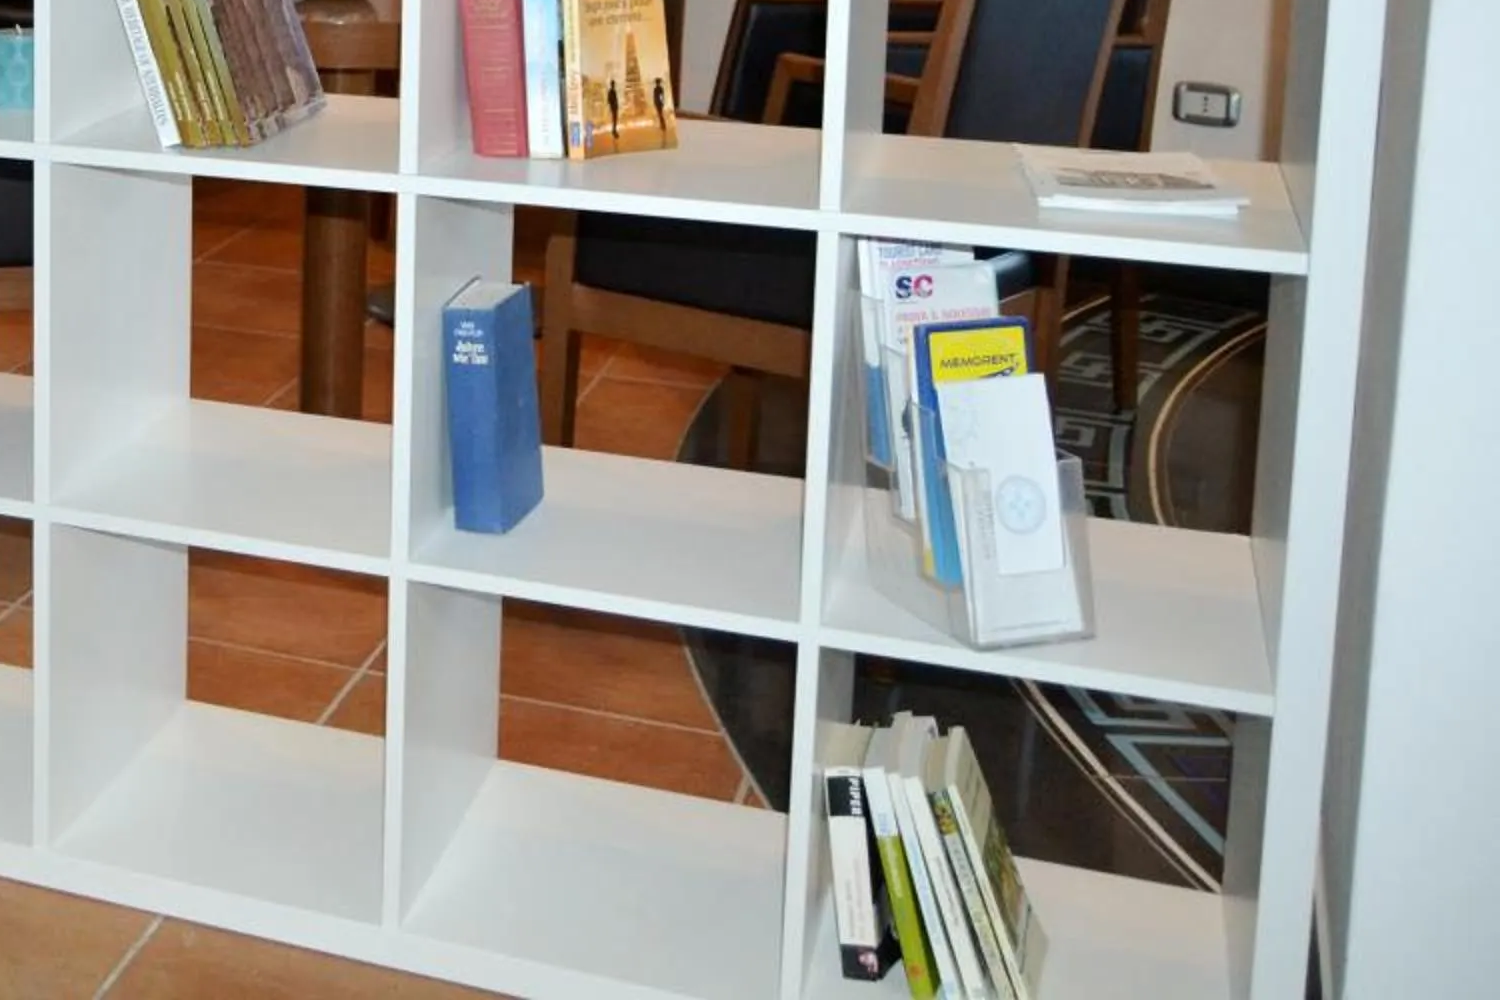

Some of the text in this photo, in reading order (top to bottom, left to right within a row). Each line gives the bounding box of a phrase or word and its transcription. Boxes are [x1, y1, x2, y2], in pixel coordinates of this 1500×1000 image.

[895, 274, 933, 298] SC
[941, 352, 1017, 369] MEMORENT
[848, 777, 862, 815] PIPER
